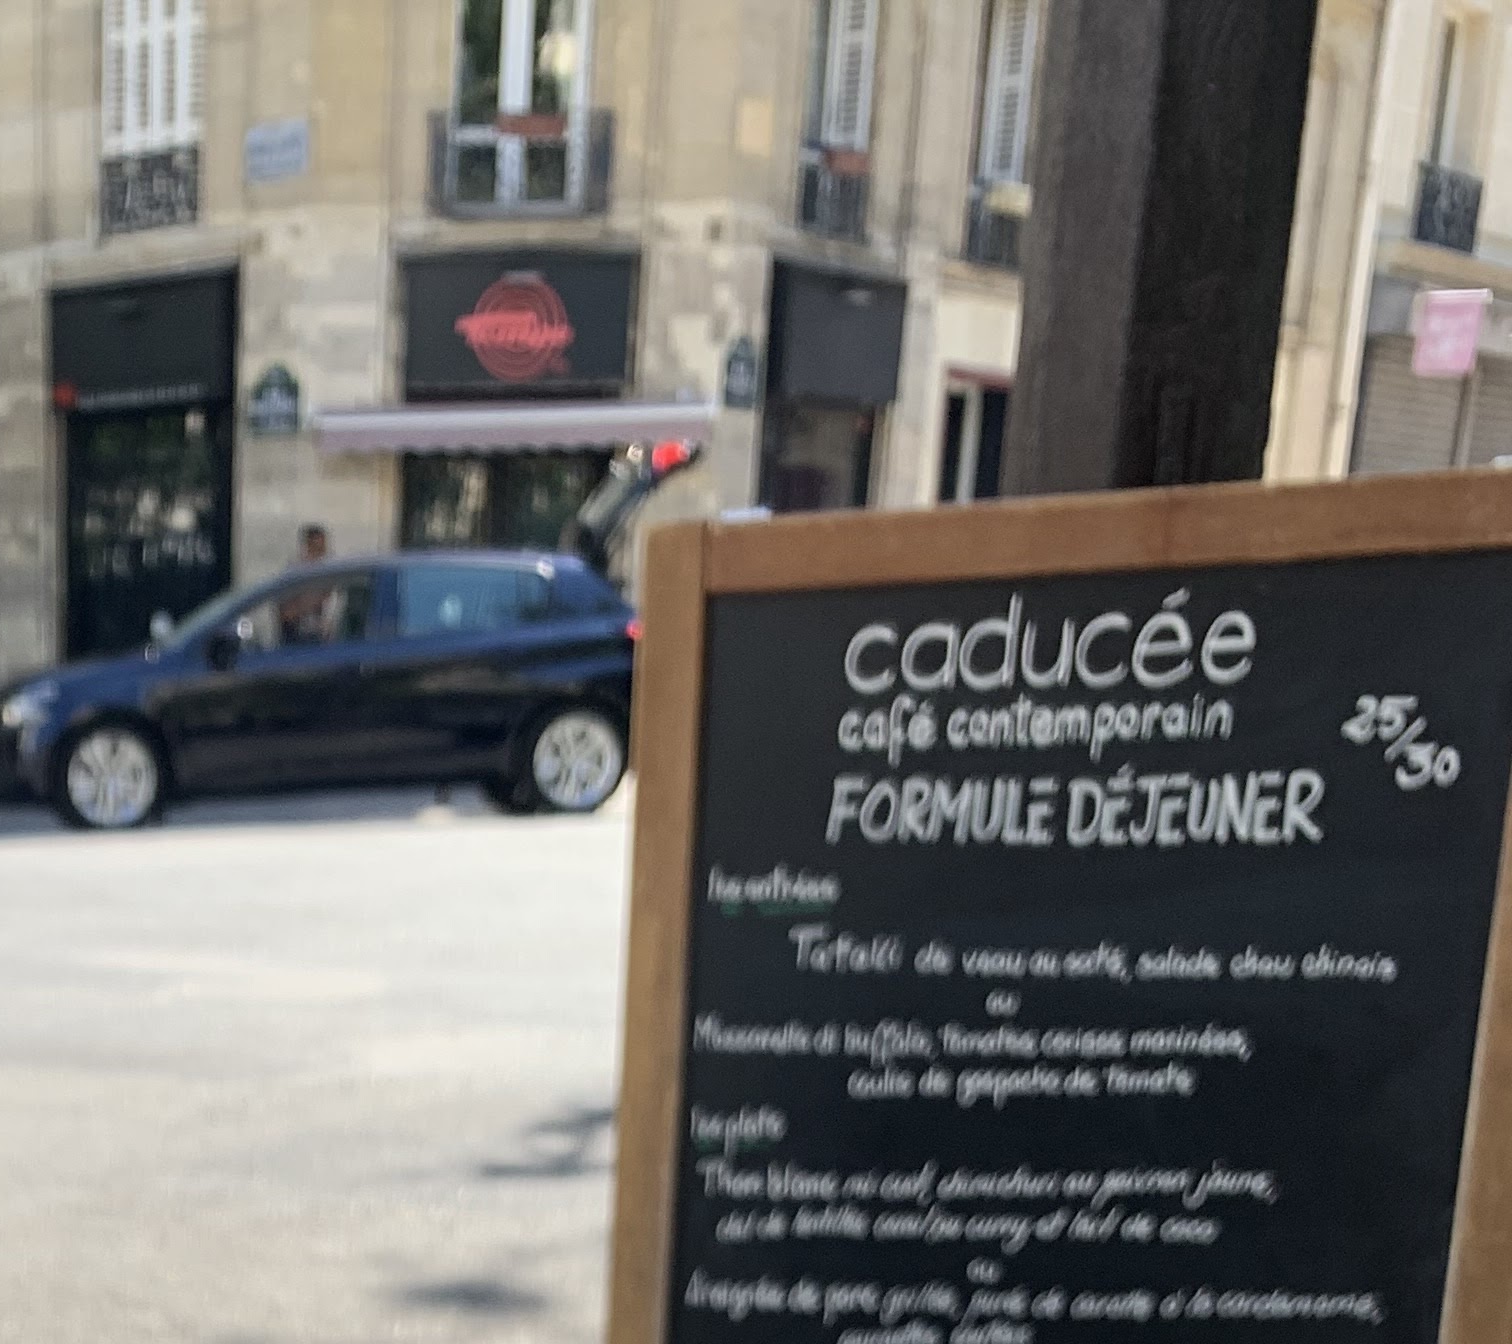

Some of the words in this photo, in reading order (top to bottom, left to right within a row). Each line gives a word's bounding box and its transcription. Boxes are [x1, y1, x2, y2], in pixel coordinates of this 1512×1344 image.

[844, 587, 1257, 694] caducée
[838, 693, 938, 769] café
[946, 691, 1235, 763] contemporain
[824, 772, 1061, 847] FORMULE
[1066, 760, 1326, 848] DÉJEUNER
